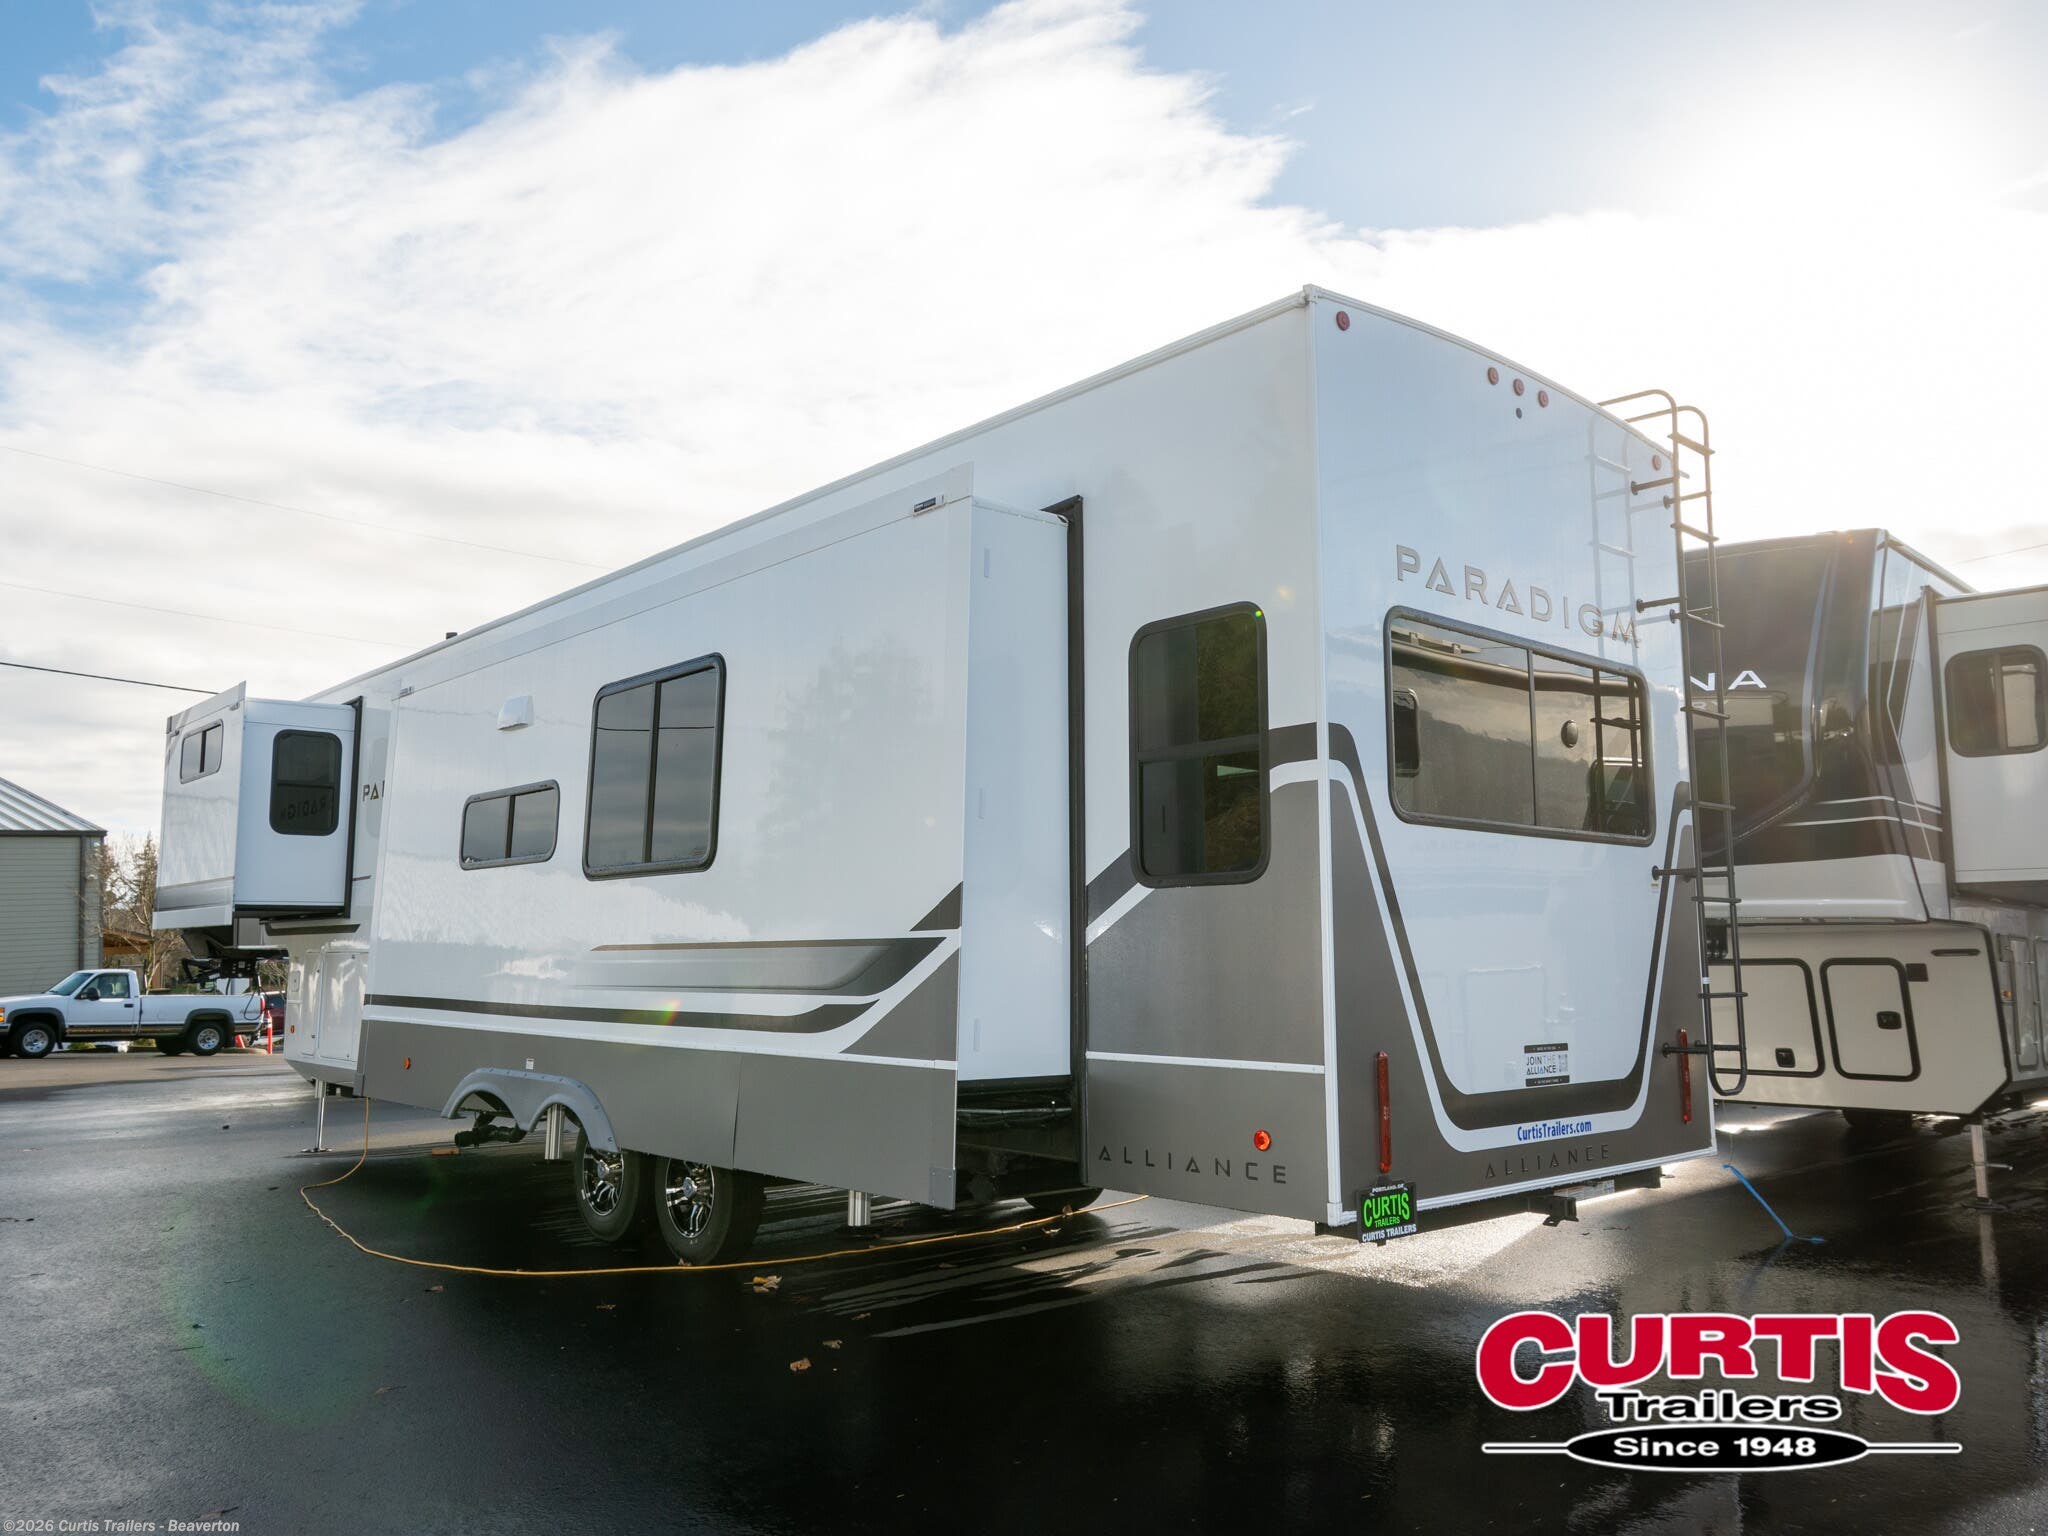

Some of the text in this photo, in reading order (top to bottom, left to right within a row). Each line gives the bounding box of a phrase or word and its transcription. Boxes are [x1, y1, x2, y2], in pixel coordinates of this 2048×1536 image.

[1396, 544, 1640, 649] PARADIGM
[362, 780, 385, 802] PA
[1526, 1065, 1557, 1075] ALLIANCE
[1517, 1120, 1592, 1141] CurtisTrailers.com
[1098, 1145, 1287, 1184] ALLIANCE
[1485, 1144, 1609, 1179] ALLIANCE
[1363, 1192, 1410, 1228] CURTIS
[1362, 1223, 1417, 1242] CURTIS TRAILERS
[1375, 1216, 1401, 1228] TRAILERS
